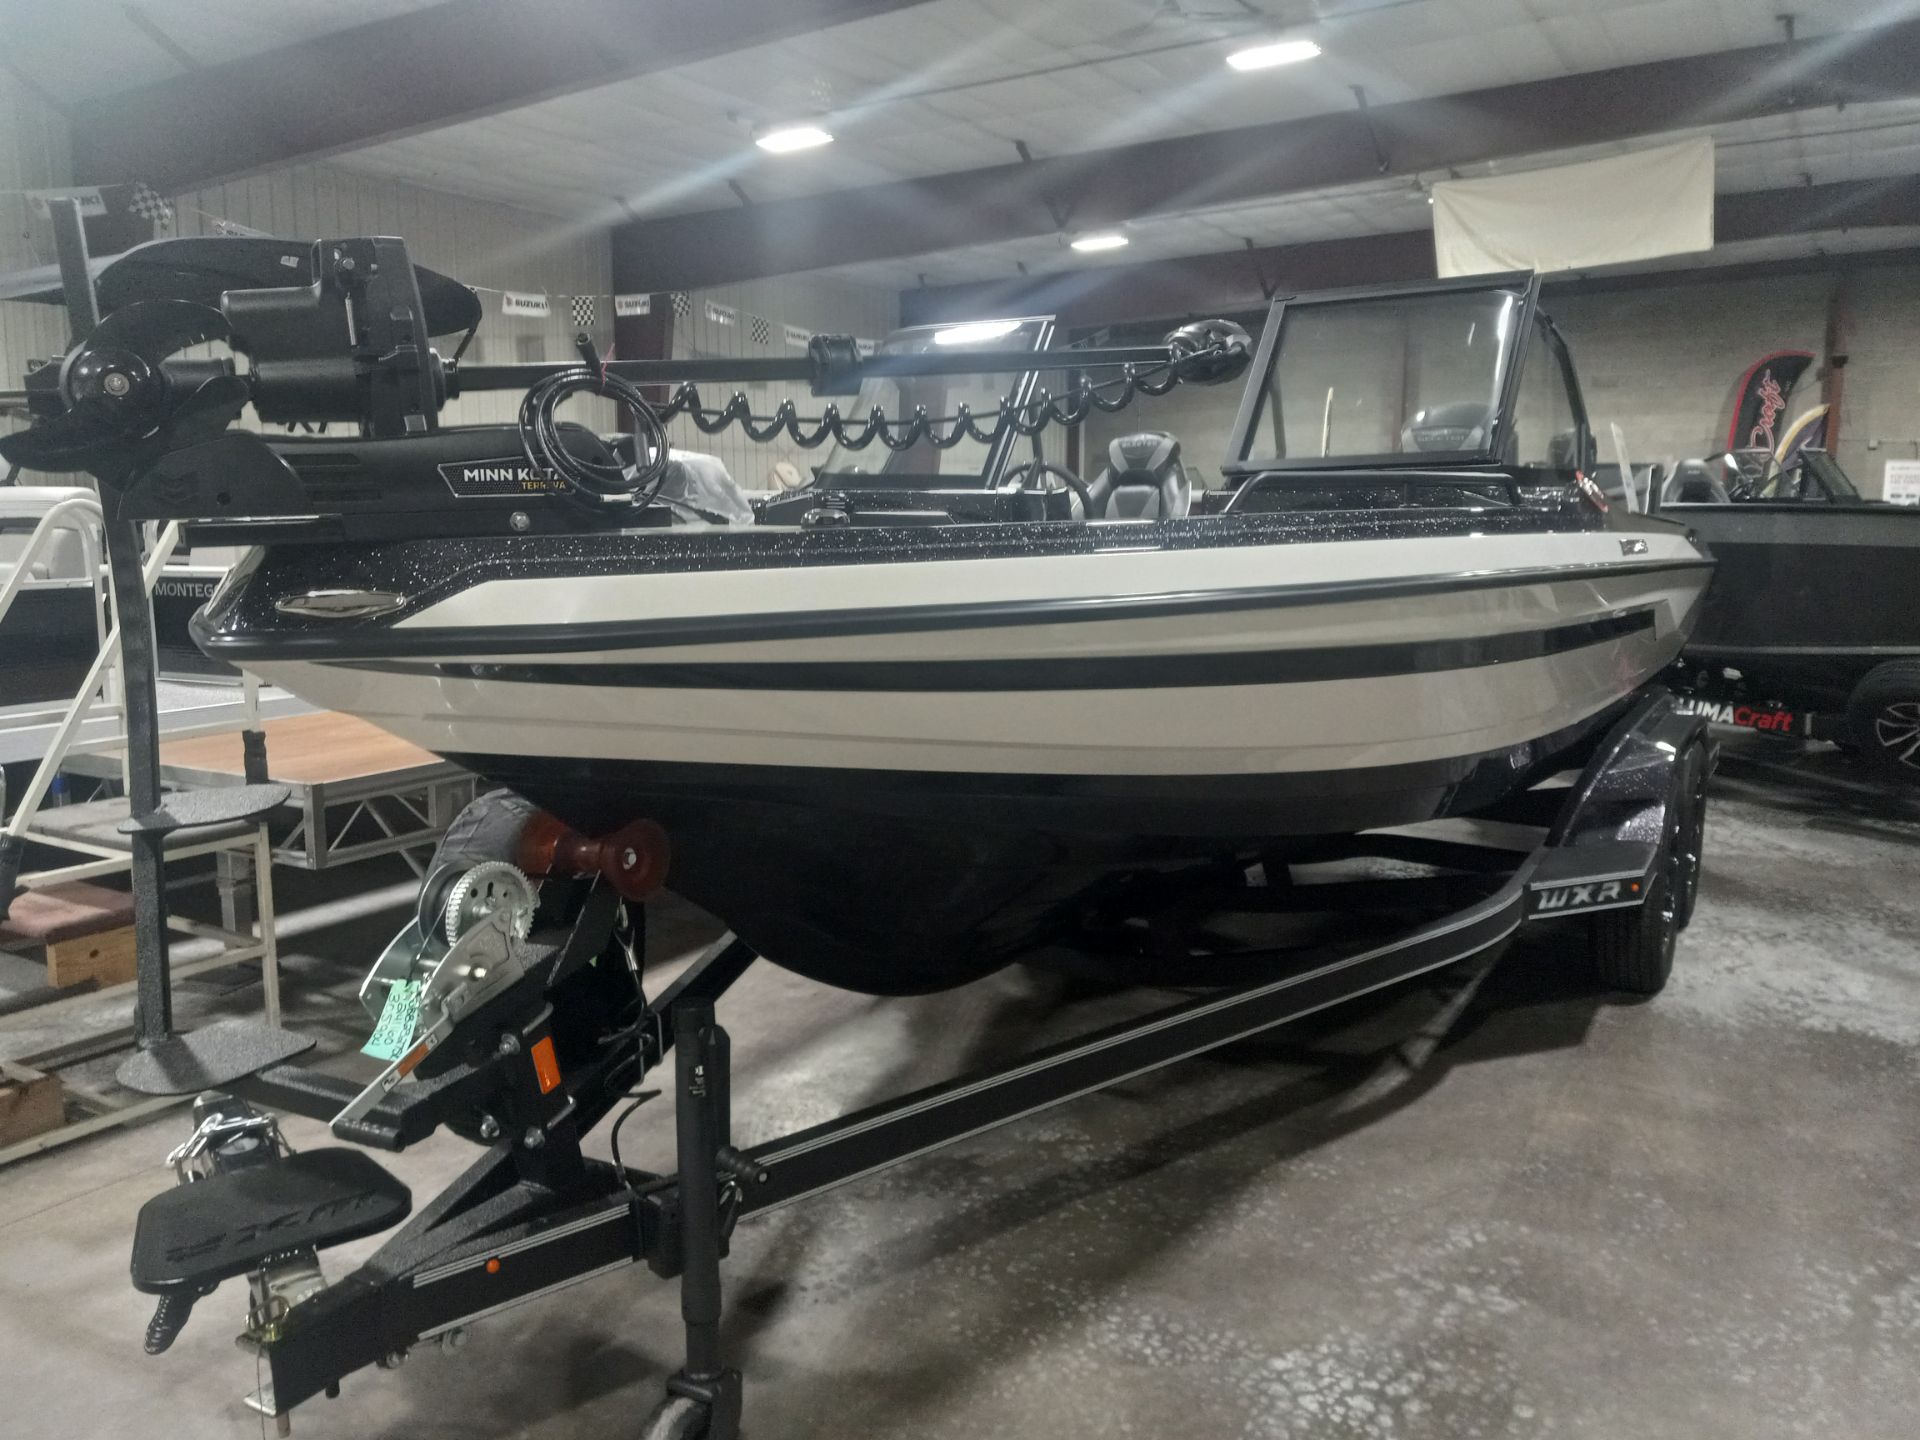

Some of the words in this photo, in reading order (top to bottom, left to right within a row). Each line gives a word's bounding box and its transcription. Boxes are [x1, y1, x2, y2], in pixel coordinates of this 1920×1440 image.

[515, 299, 548, 310] SUZUKI
[464, 469, 513, 482] MINN
[521, 480, 567, 491] TERRVA
[155, 583, 219, 598] MONTEG
[1538, 881, 1621, 910] WXR
